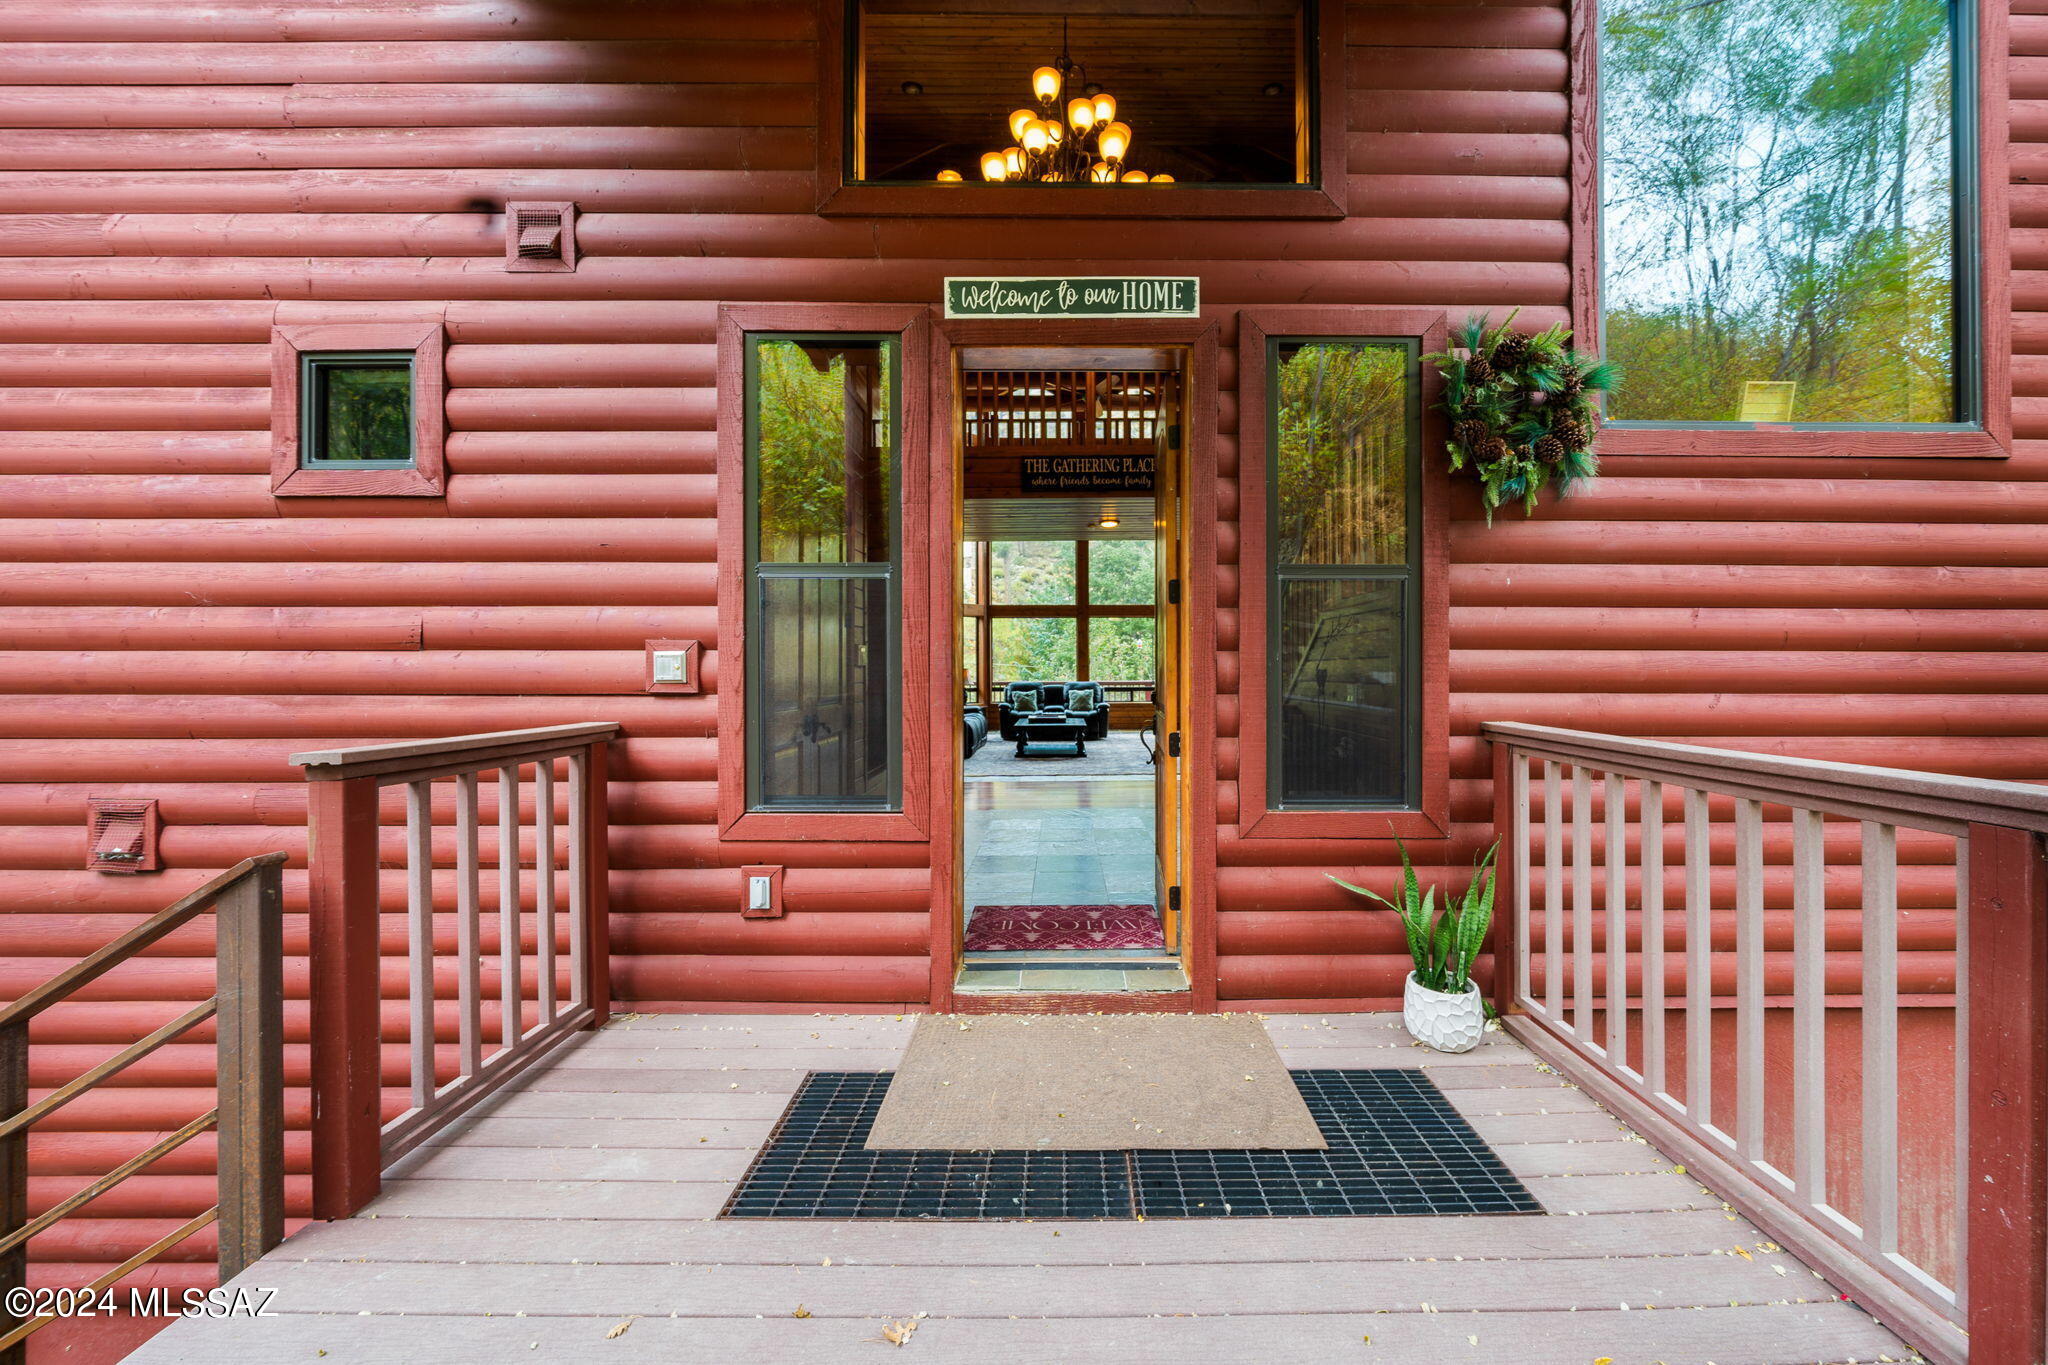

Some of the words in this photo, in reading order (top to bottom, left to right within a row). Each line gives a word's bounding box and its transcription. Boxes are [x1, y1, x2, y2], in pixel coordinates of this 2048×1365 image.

[1056, 281, 1079, 310] to
[1084, 289, 1120, 305] our
[1122, 281, 1184, 310] HOME
[1024, 458, 1050, 473] THE
[1053, 458, 1120, 473] GATHERING
[1031, 475, 1057, 486] where
[1059, 475, 1090, 487] friends
[1092, 475, 1121, 485] become
[1124, 475, 1152, 487] family
[991, 918, 1137, 931] WELCOME
